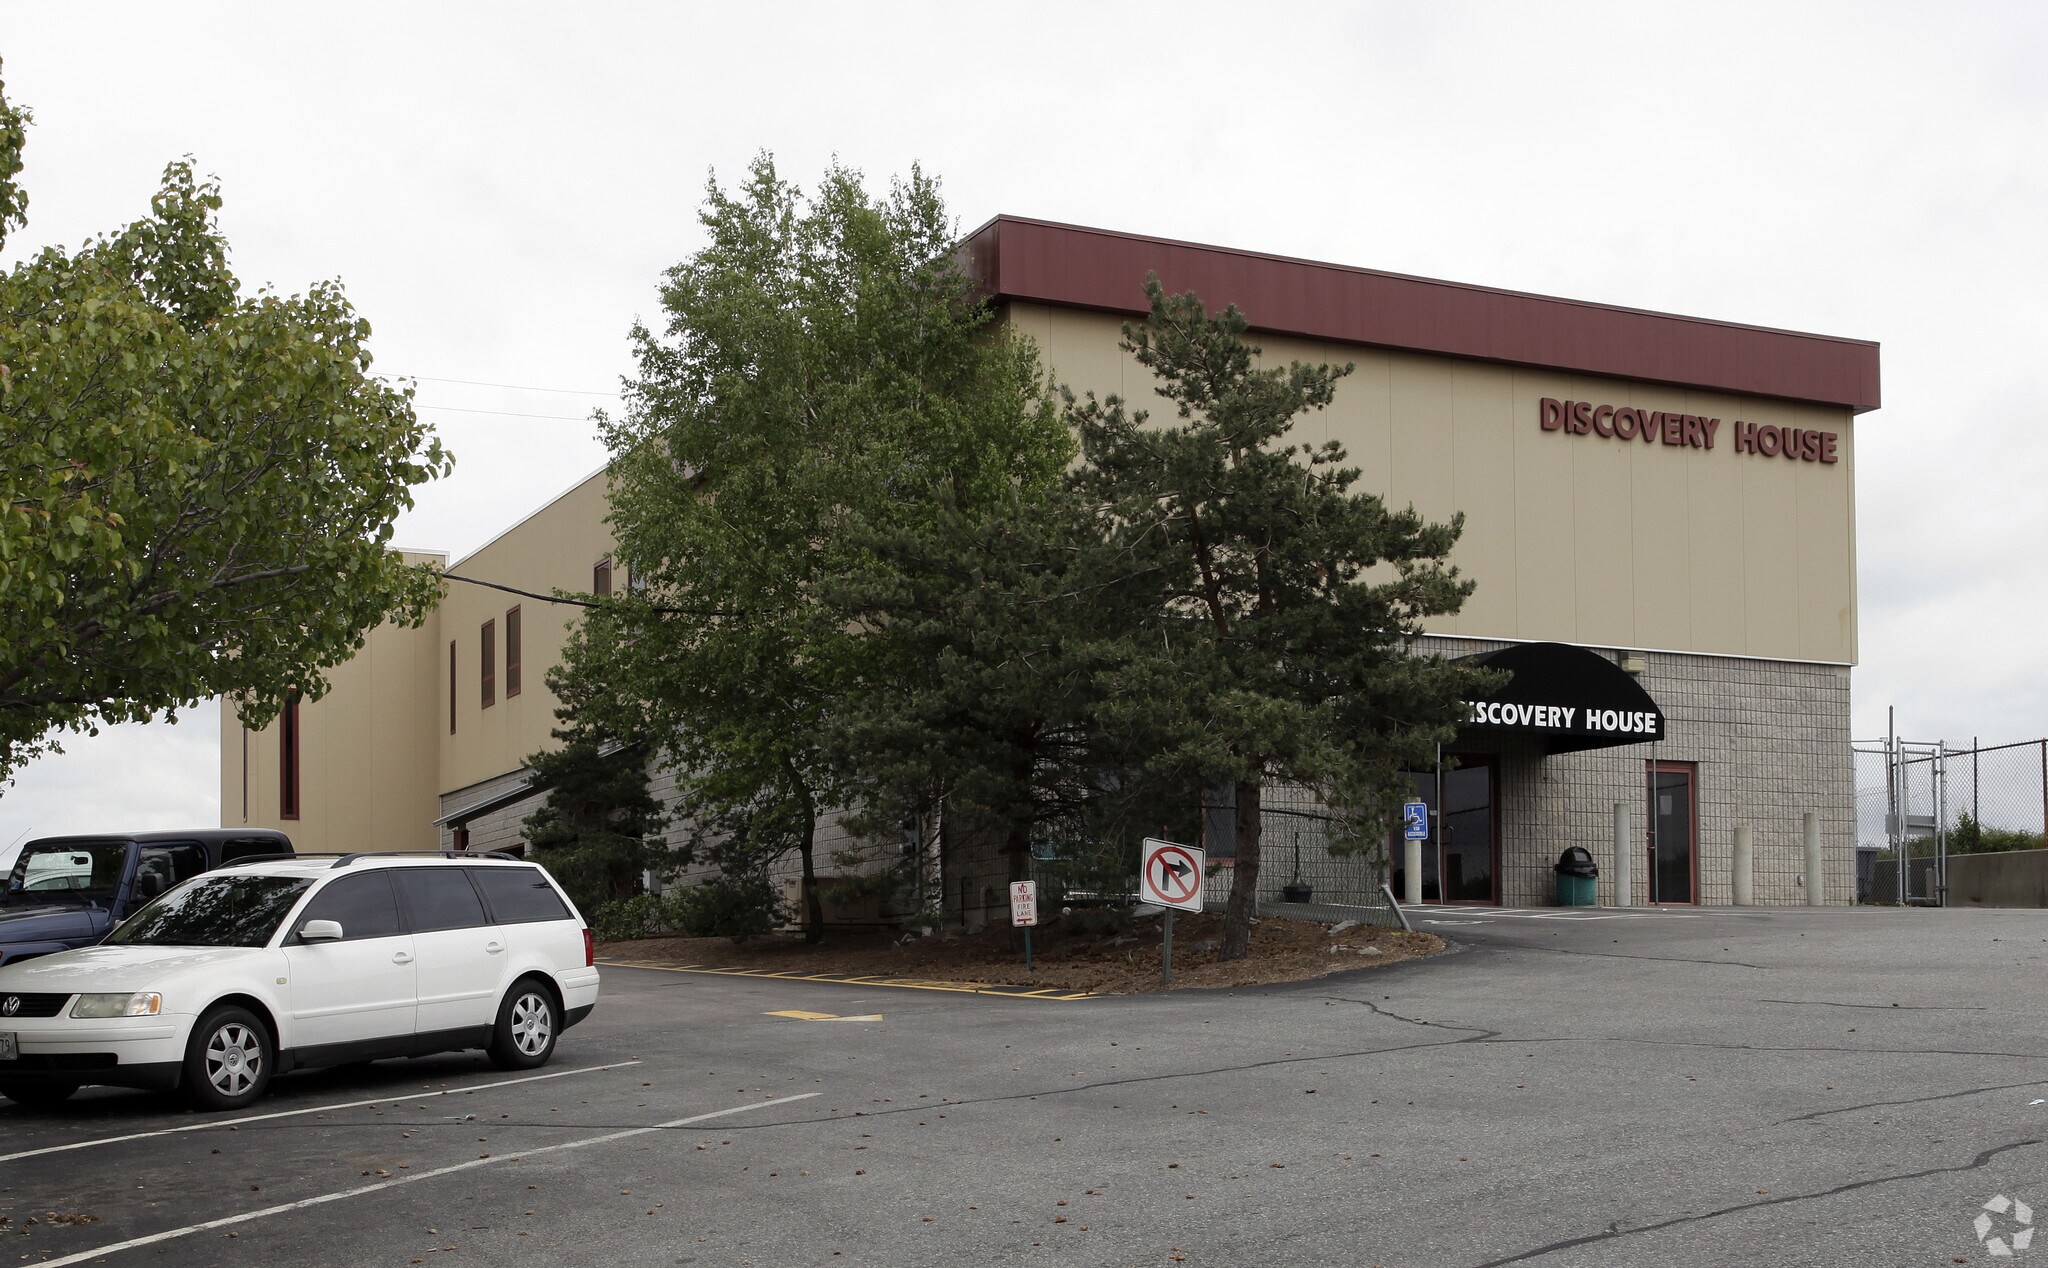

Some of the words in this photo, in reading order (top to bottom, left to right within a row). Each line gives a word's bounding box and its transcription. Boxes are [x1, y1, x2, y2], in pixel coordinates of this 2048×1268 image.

[1540, 397, 1721, 449] DISCOVERY
[1735, 420, 1839, 464] HOUSE
[1458, 700, 1576, 728] ISCOVERY
[1586, 708, 1657, 734] HOUSE
[1014, 894, 1033, 903] PARKING
[1018, 886, 1028, 894] NO
